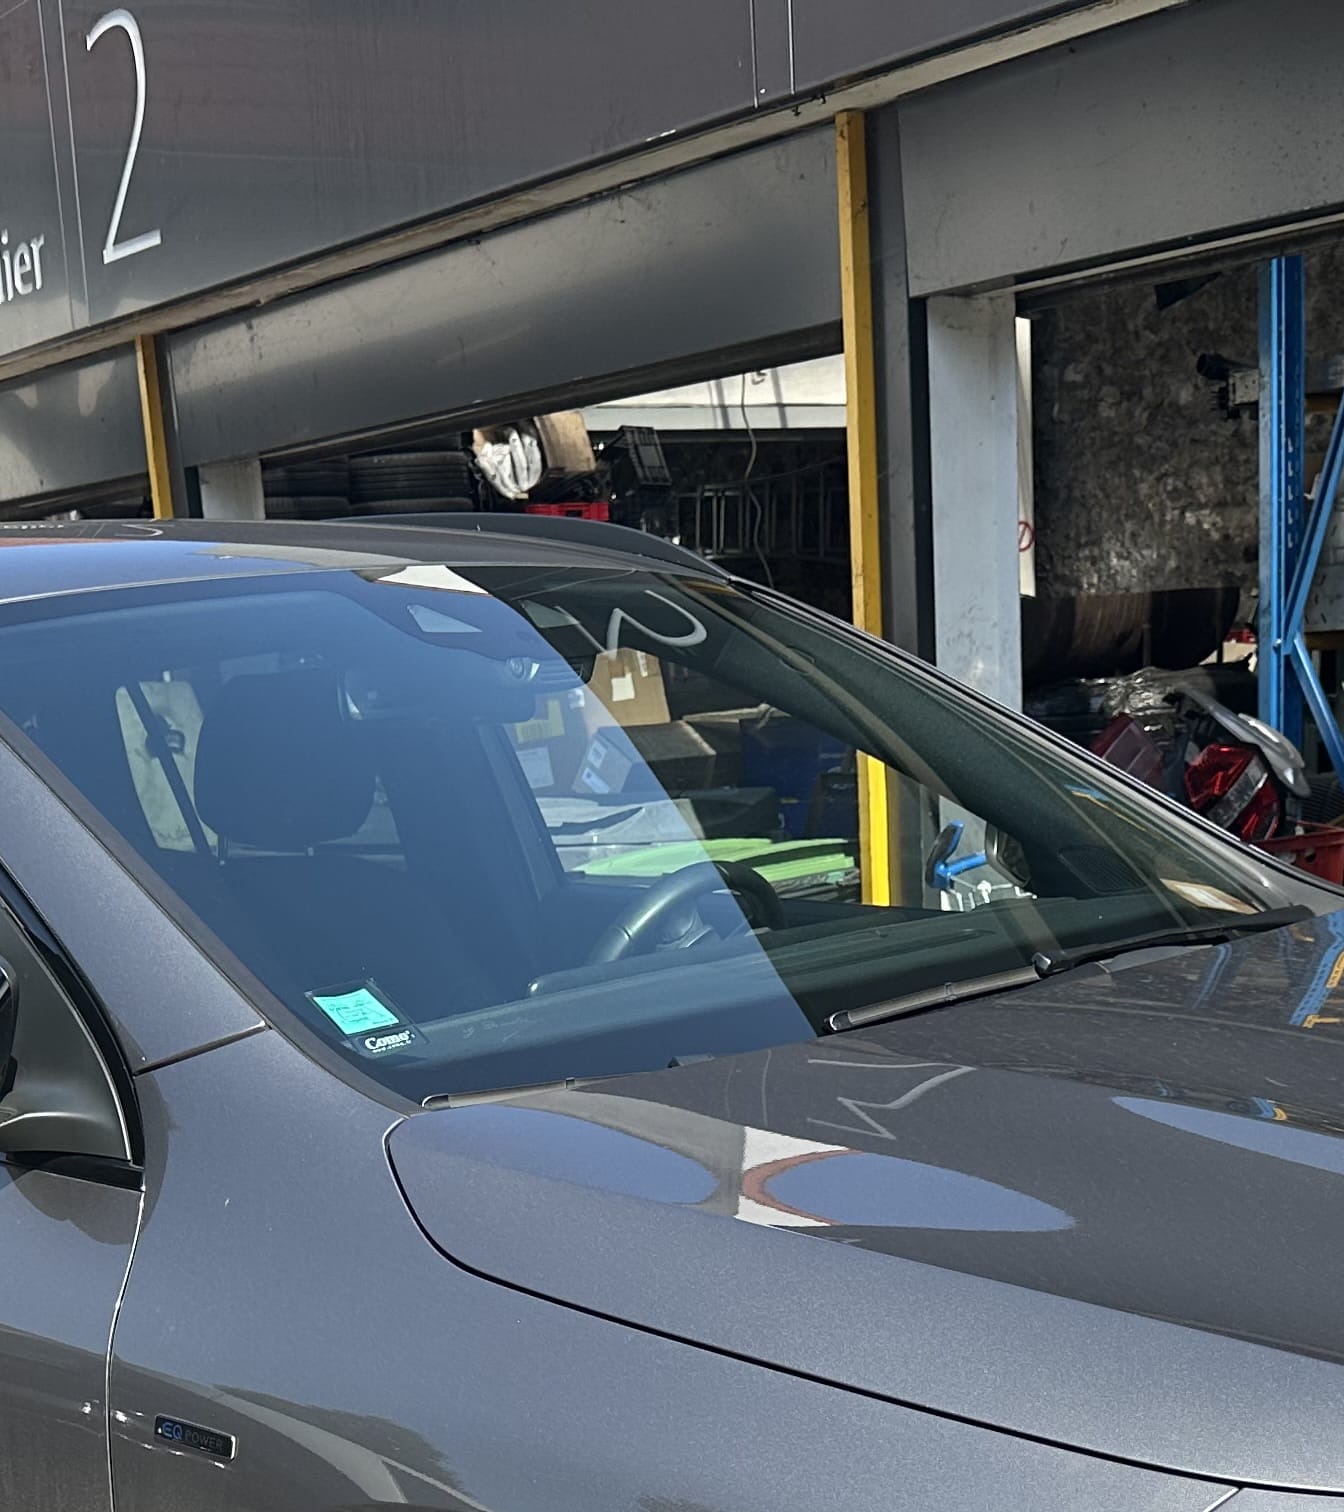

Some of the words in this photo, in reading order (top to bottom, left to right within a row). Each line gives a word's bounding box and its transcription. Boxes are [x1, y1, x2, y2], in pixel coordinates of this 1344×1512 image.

[86, 7, 162, 265] 2
[161, 1420, 184, 1441] EQ
[185, 1429, 224, 1450] POWER
